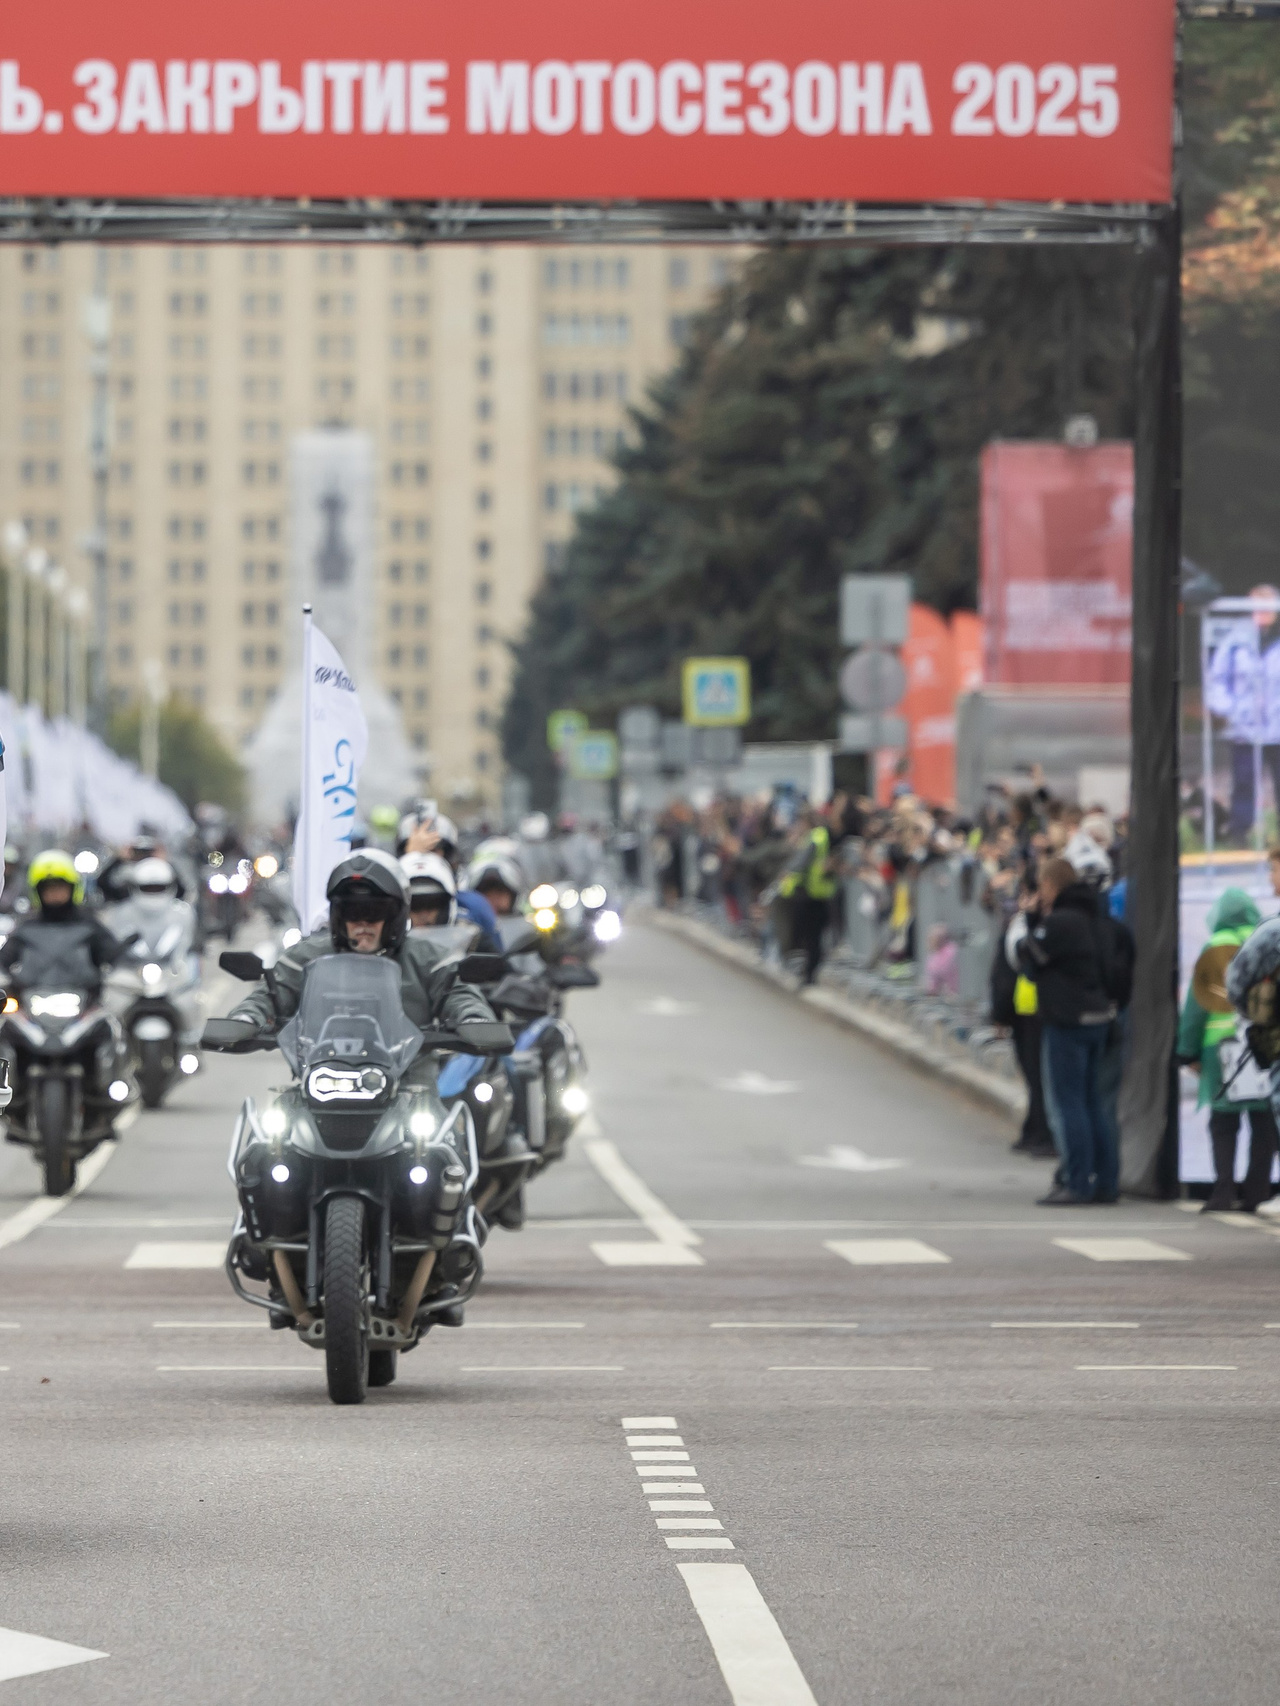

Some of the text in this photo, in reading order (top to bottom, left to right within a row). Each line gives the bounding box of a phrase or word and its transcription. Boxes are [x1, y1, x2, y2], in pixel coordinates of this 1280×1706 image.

[71, 58, 450, 135] ЗАКРЫТИЕ
[464, 60, 932, 136] МОТОСЕЗОНА
[950, 63, 1120, 137] 2025
